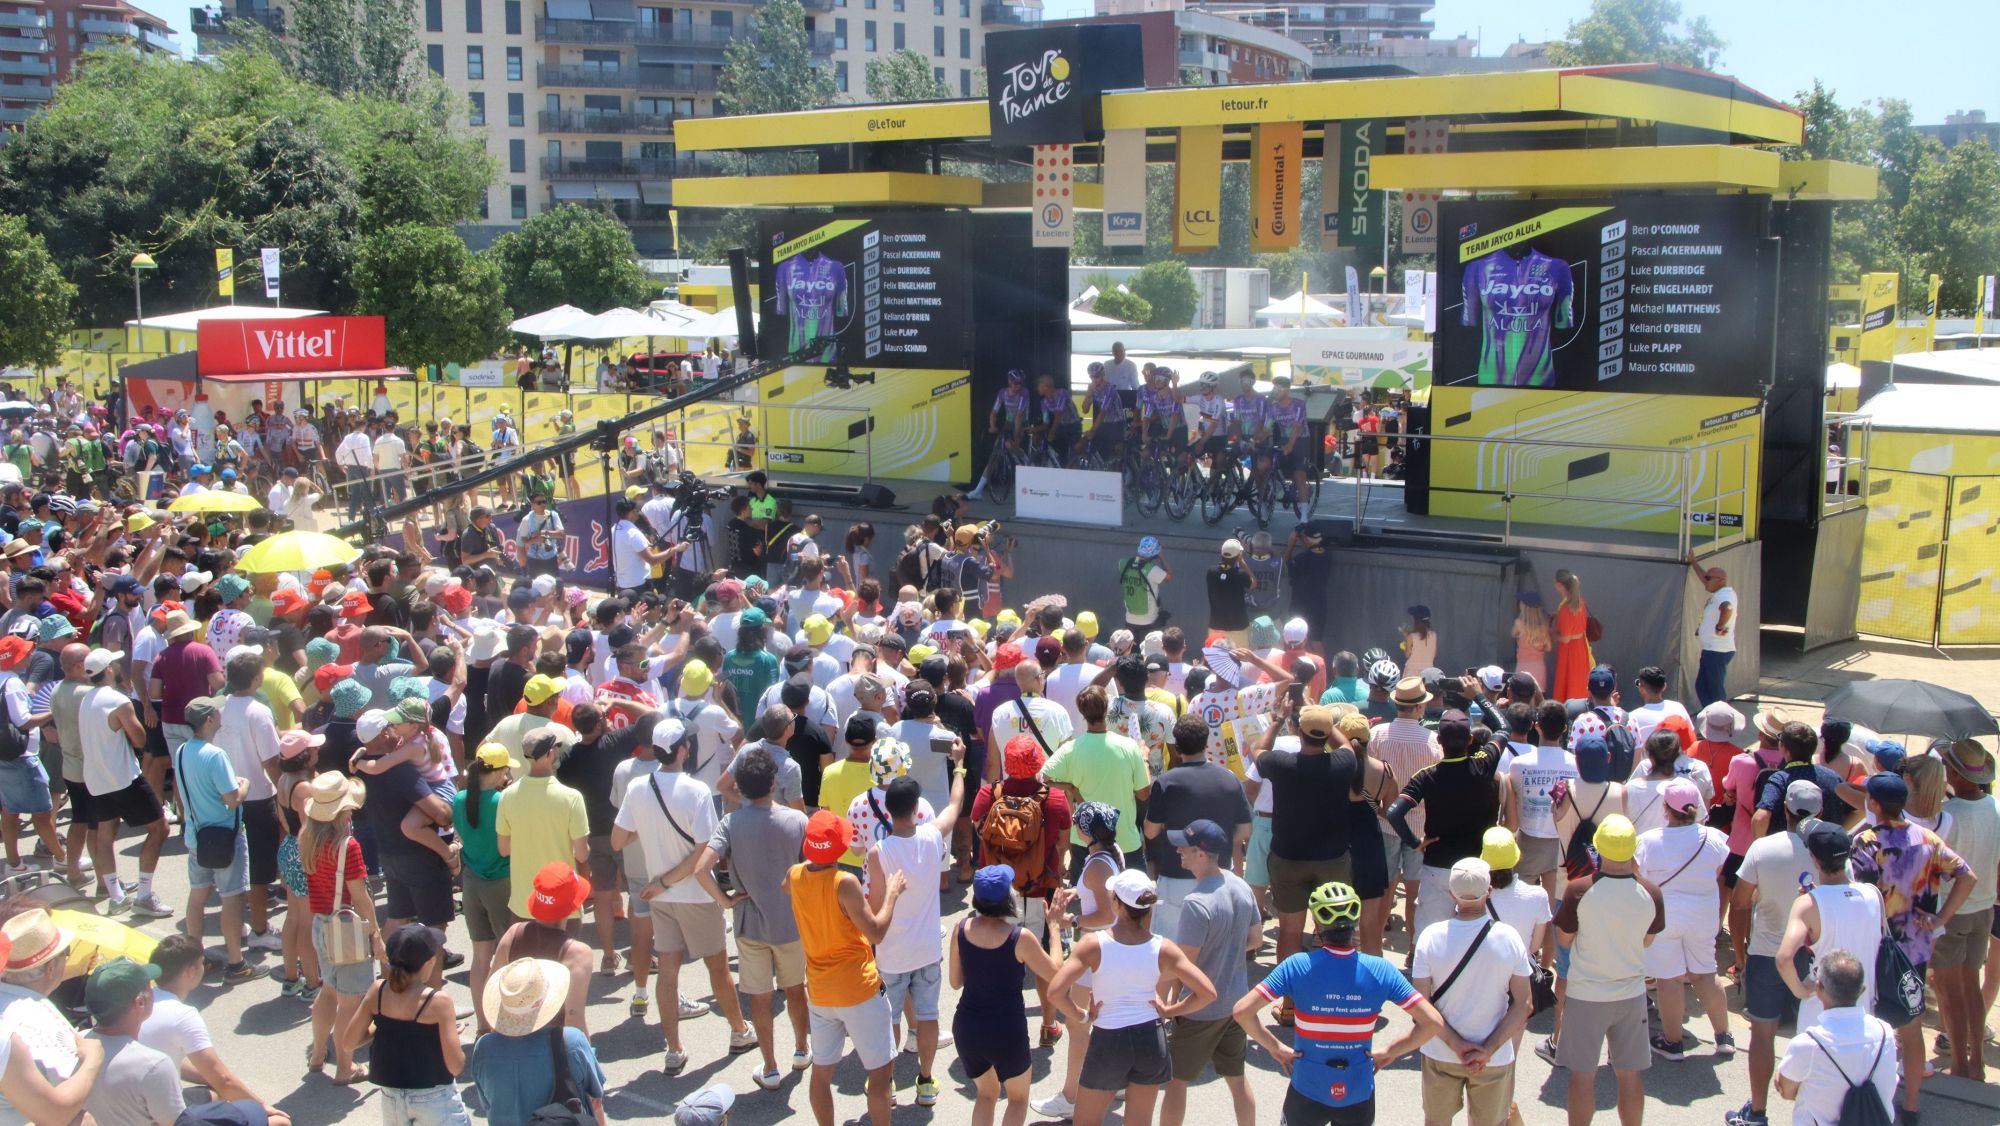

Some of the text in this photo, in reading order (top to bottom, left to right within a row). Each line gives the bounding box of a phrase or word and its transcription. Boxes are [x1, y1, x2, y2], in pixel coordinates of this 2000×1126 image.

[1043, 75, 1053, 89] de
[1221, 97, 1268, 111] letour.fr
[868, 118, 906, 131] @LeTour
[1272, 155, 1285, 236] Continental
[1112, 215, 1136, 228] Krys
[1185, 210, 1216, 223] LCL
[1608, 224, 1700, 238] 111 Ben O'CONNOR
[777, 246, 793, 258] TEAM
[809, 230, 826, 243] ALULA
[883, 234, 894, 242] Ben
[894, 234, 927, 242] O'CONNOR
[1466, 221, 1542, 255] TEAM JAYCO ALULA
[883, 251, 901, 259] Pascal
[902, 250, 941, 259] ACKERMANN
[1607, 245, 1722, 257] 112 Pascal ACKERMANN
[883, 266, 897, 275] Luke
[897, 266, 931, 275] DURBRIDGE
[1606, 265, 1705, 278] 113 Luke DURBRIDGE
[788, 278, 835, 293] Jayco
[883, 281, 897, 290] Felix
[897, 281, 937, 290] ENGELHARDT
[1481, 279, 1553, 299] Jayco
[1605, 284, 1714, 297] 114 Felix ENGELHARDT
[883, 297, 906, 305] Michael
[906, 297, 942, 306] MATTHEWS
[1605, 303, 1721, 317] 115 Michael MATTHEWS
[883, 312, 905, 321] Kelland
[905, 313, 930, 322] O'BRIEN
[1489, 317, 1543, 333] ALULA
[1604, 323, 1702, 336] 116 Kelland O'BRIEN
[884, 328, 898, 336] Luke
[898, 328, 919, 337] PLAPP
[254, 329, 334, 360] Vittel
[884, 343, 904, 352] Mauro
[903, 344, 928, 353] SCHMID
[1604, 343, 1682, 356] 117 Luke PLAPP
[1321, 350, 1385, 361] ESPACE GOURMAND
[1603, 362, 1695, 375] 118 Mauro SCHMID
[1731, 407, 1757, 420] @LeTour
[769, 452, 784, 461] UCI
[730, 668, 754, 676] ALONSO
[1531, 776, 1551, 786] KEEP
